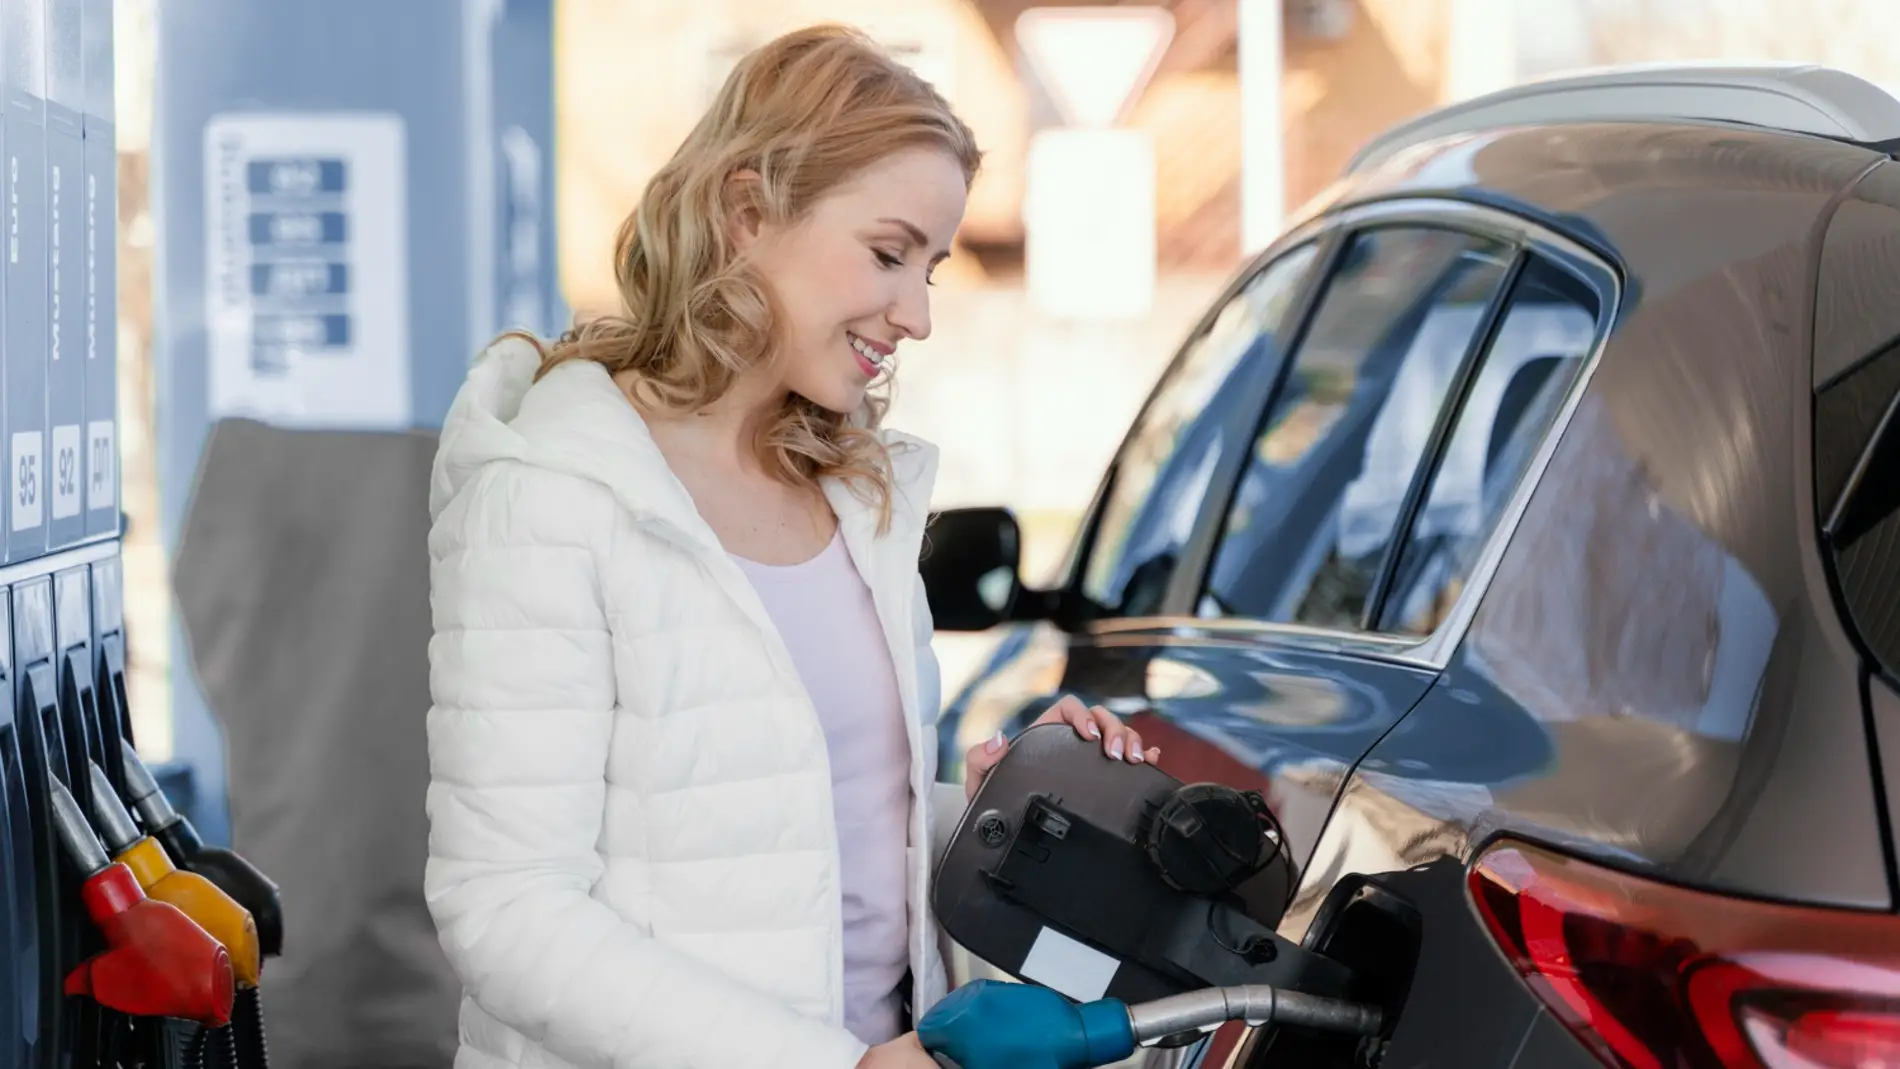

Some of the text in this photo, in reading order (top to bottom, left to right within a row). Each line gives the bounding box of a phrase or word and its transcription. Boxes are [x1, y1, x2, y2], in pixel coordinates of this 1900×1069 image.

[10, 157, 19, 264] Euro
[52, 165, 61, 361] Mustang
[18, 454, 36, 507] 95
[58, 447, 74, 497] 92
